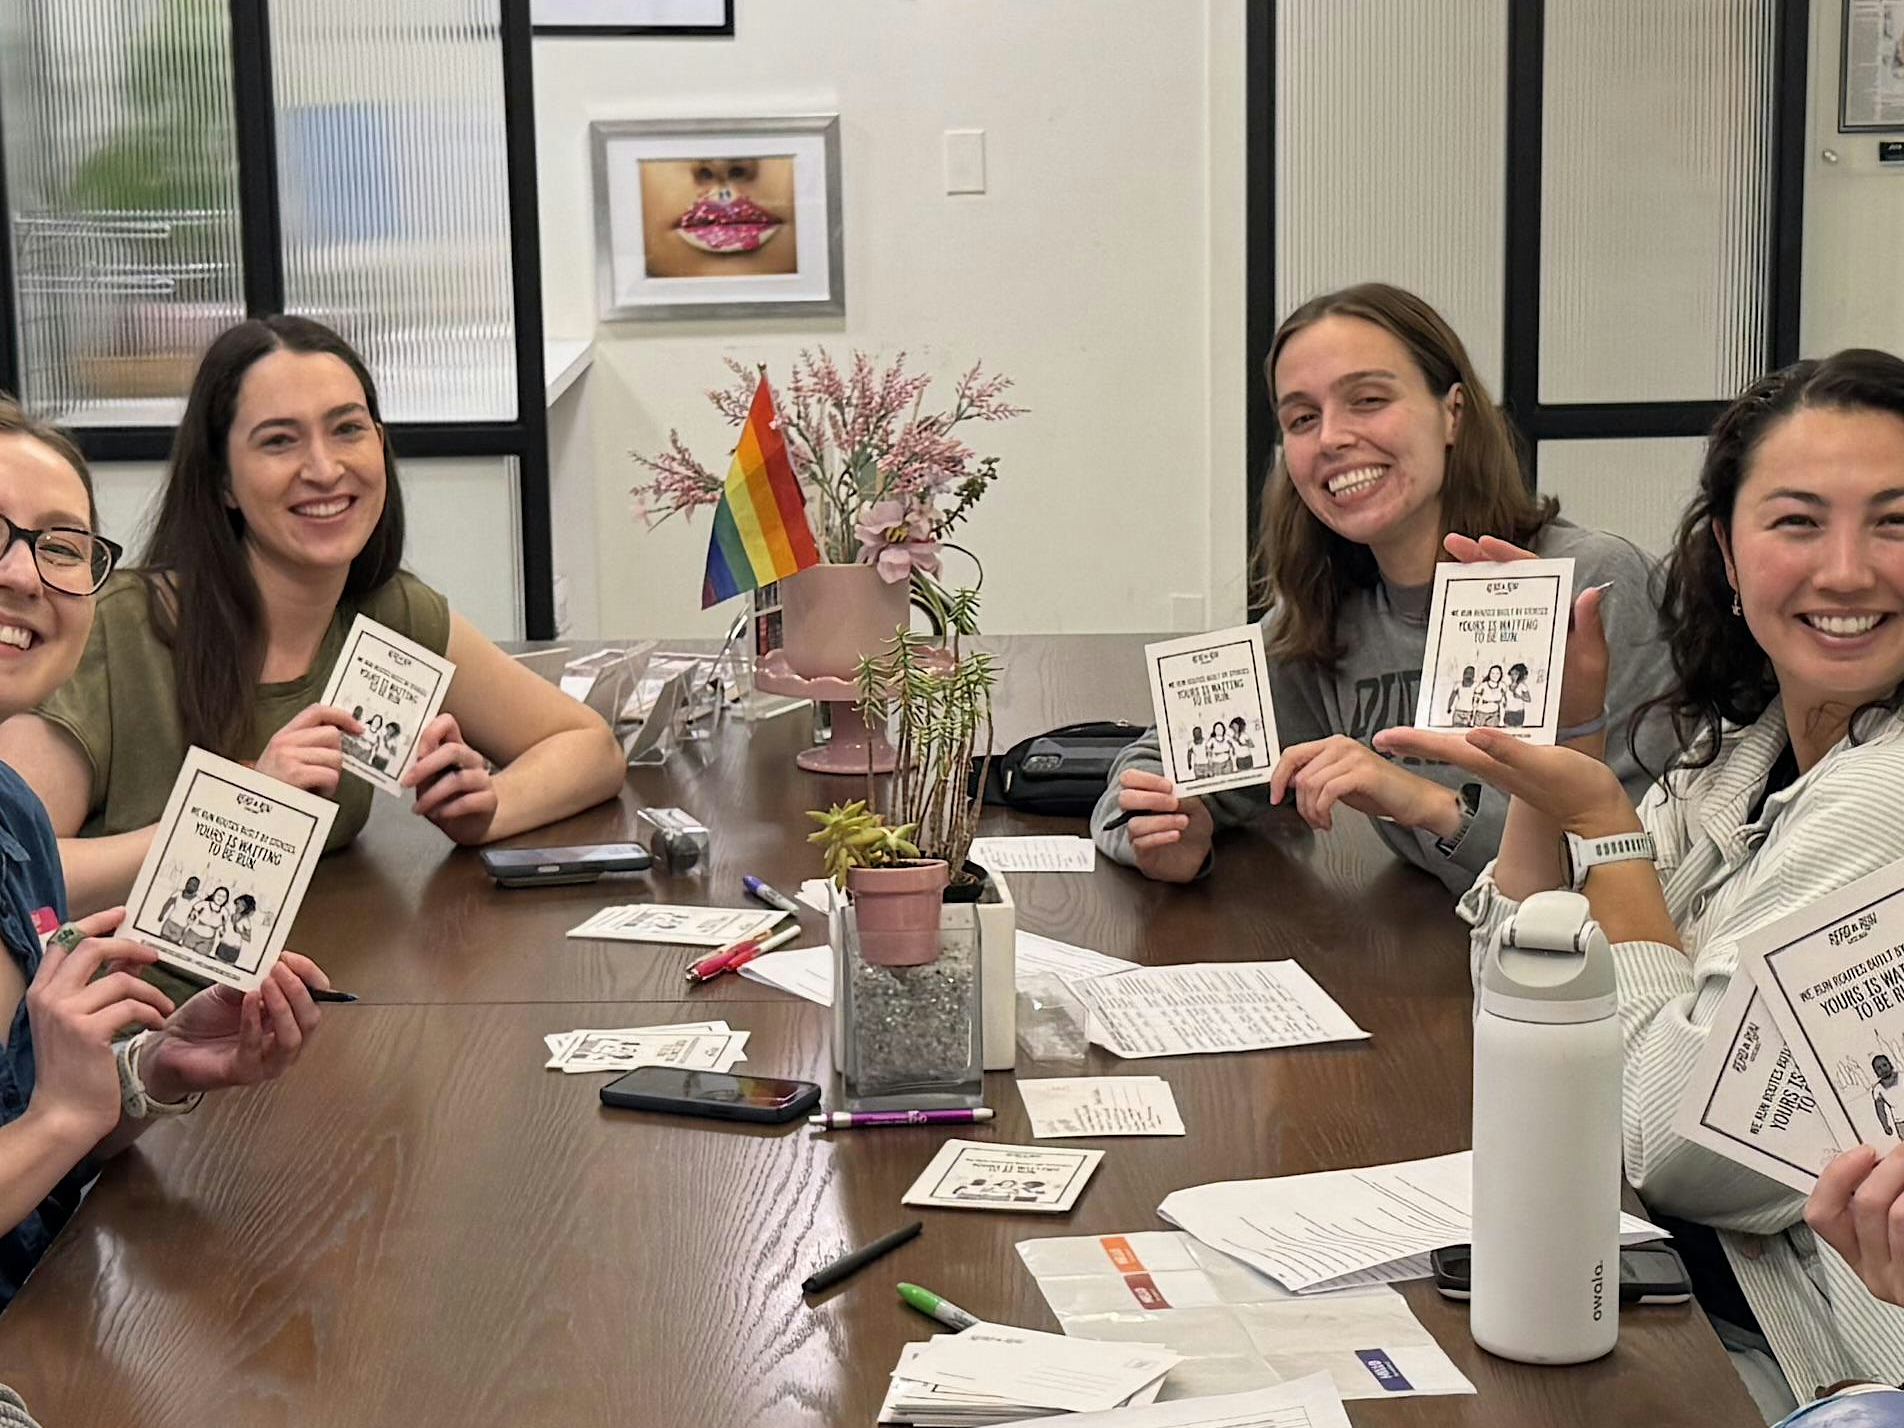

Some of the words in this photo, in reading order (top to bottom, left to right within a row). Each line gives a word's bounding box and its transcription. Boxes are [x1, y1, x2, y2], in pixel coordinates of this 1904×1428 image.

[1832, 963, 1867, 988] ROUTES
[1866, 949, 1894, 972] BUILT
[1819, 985, 1865, 1017] YOURS
[1863, 977, 1882, 998] IS
[1852, 1000, 1874, 1021] TO
[1872, 991, 1895, 1014] BE
[1769, 1088, 1800, 1131] YOURS
[1796, 1094, 1818, 1114] TO
[1592, 1263, 1604, 1322] owala
